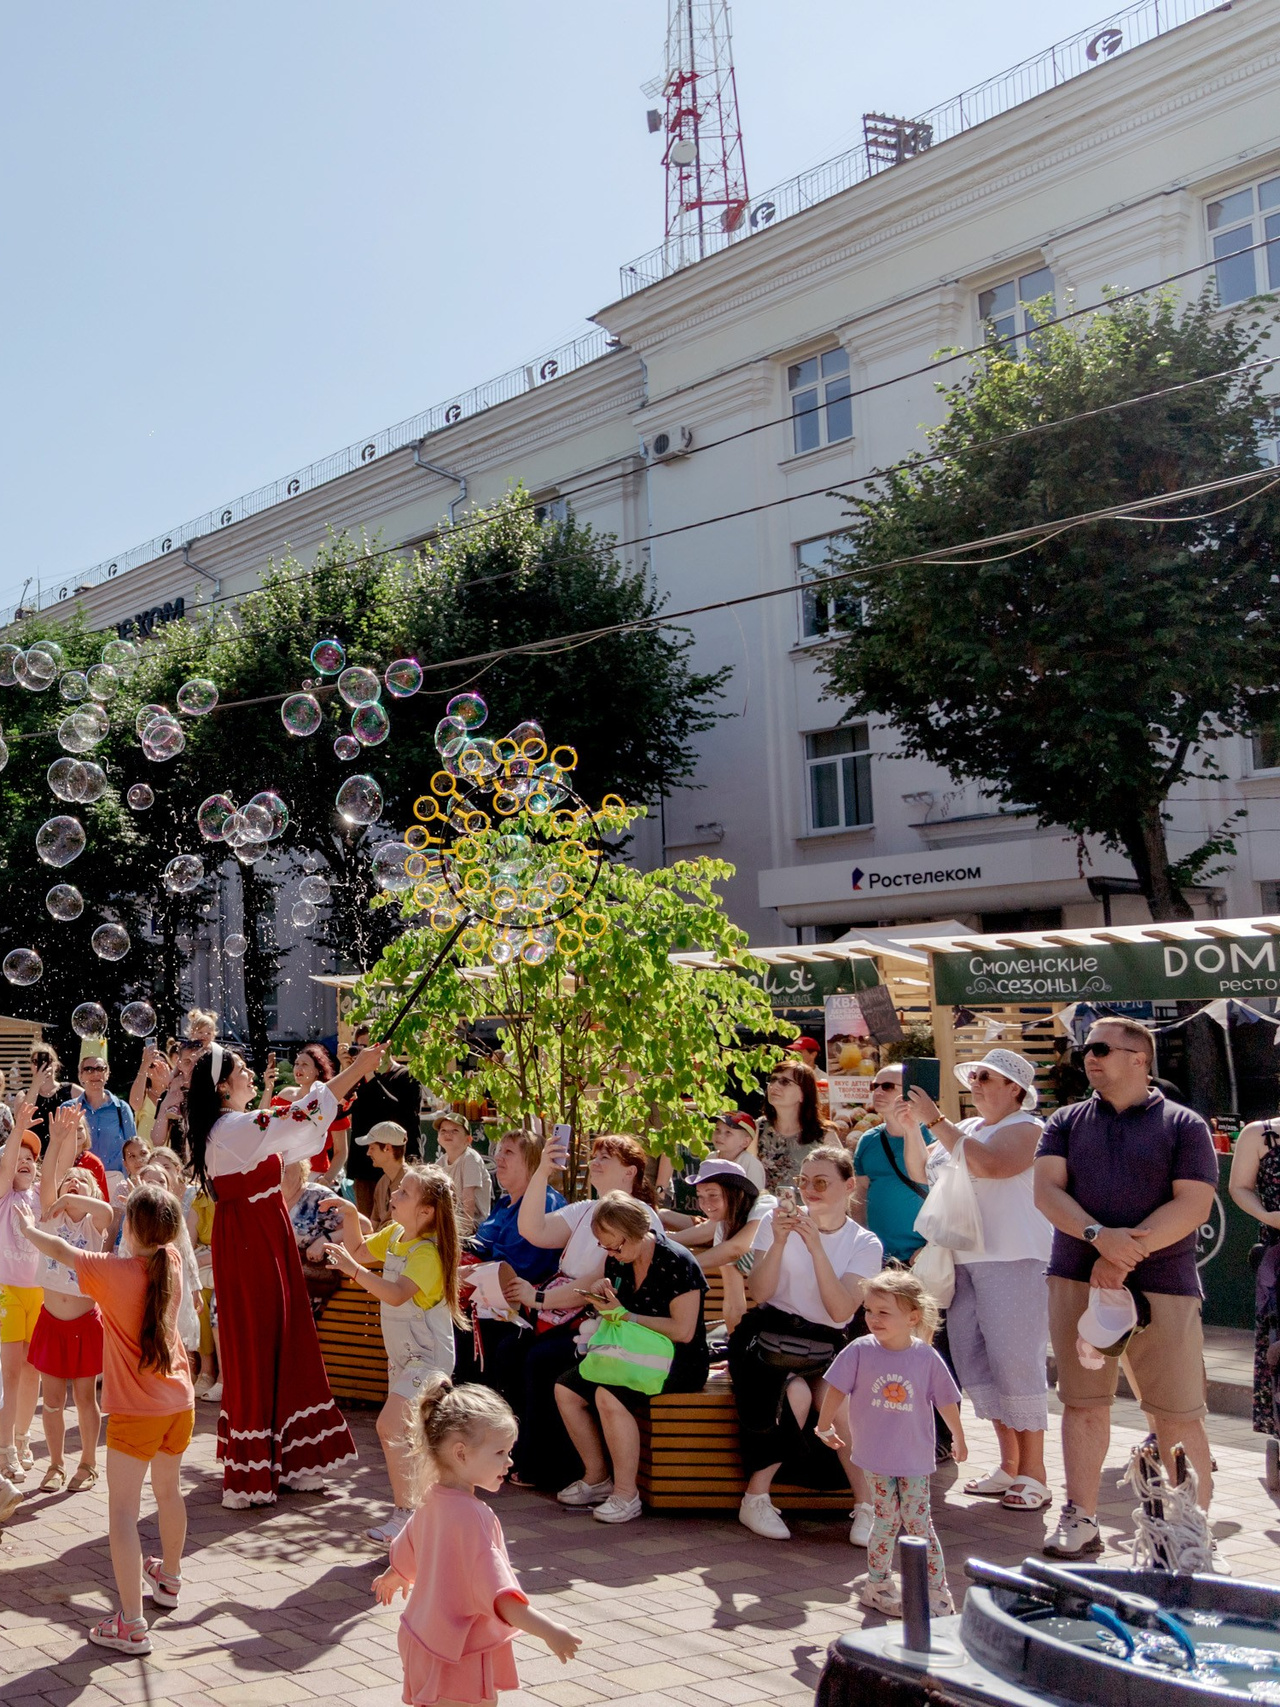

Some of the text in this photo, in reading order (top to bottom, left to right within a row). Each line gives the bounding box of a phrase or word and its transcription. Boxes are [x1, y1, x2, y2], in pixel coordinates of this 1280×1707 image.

[869, 867, 982, 889] Ростелеком
[970, 956, 1098, 976] Смоленские
[1163, 942, 1280, 978] DOM
[997, 977, 1078, 995] сезоны
[832, 997, 860, 1008] КВА
[871, 1375, 886, 1394] CUTE
[886, 1373, 903, 1383] AND
[883, 1400, 914, 1412] SUGAR
